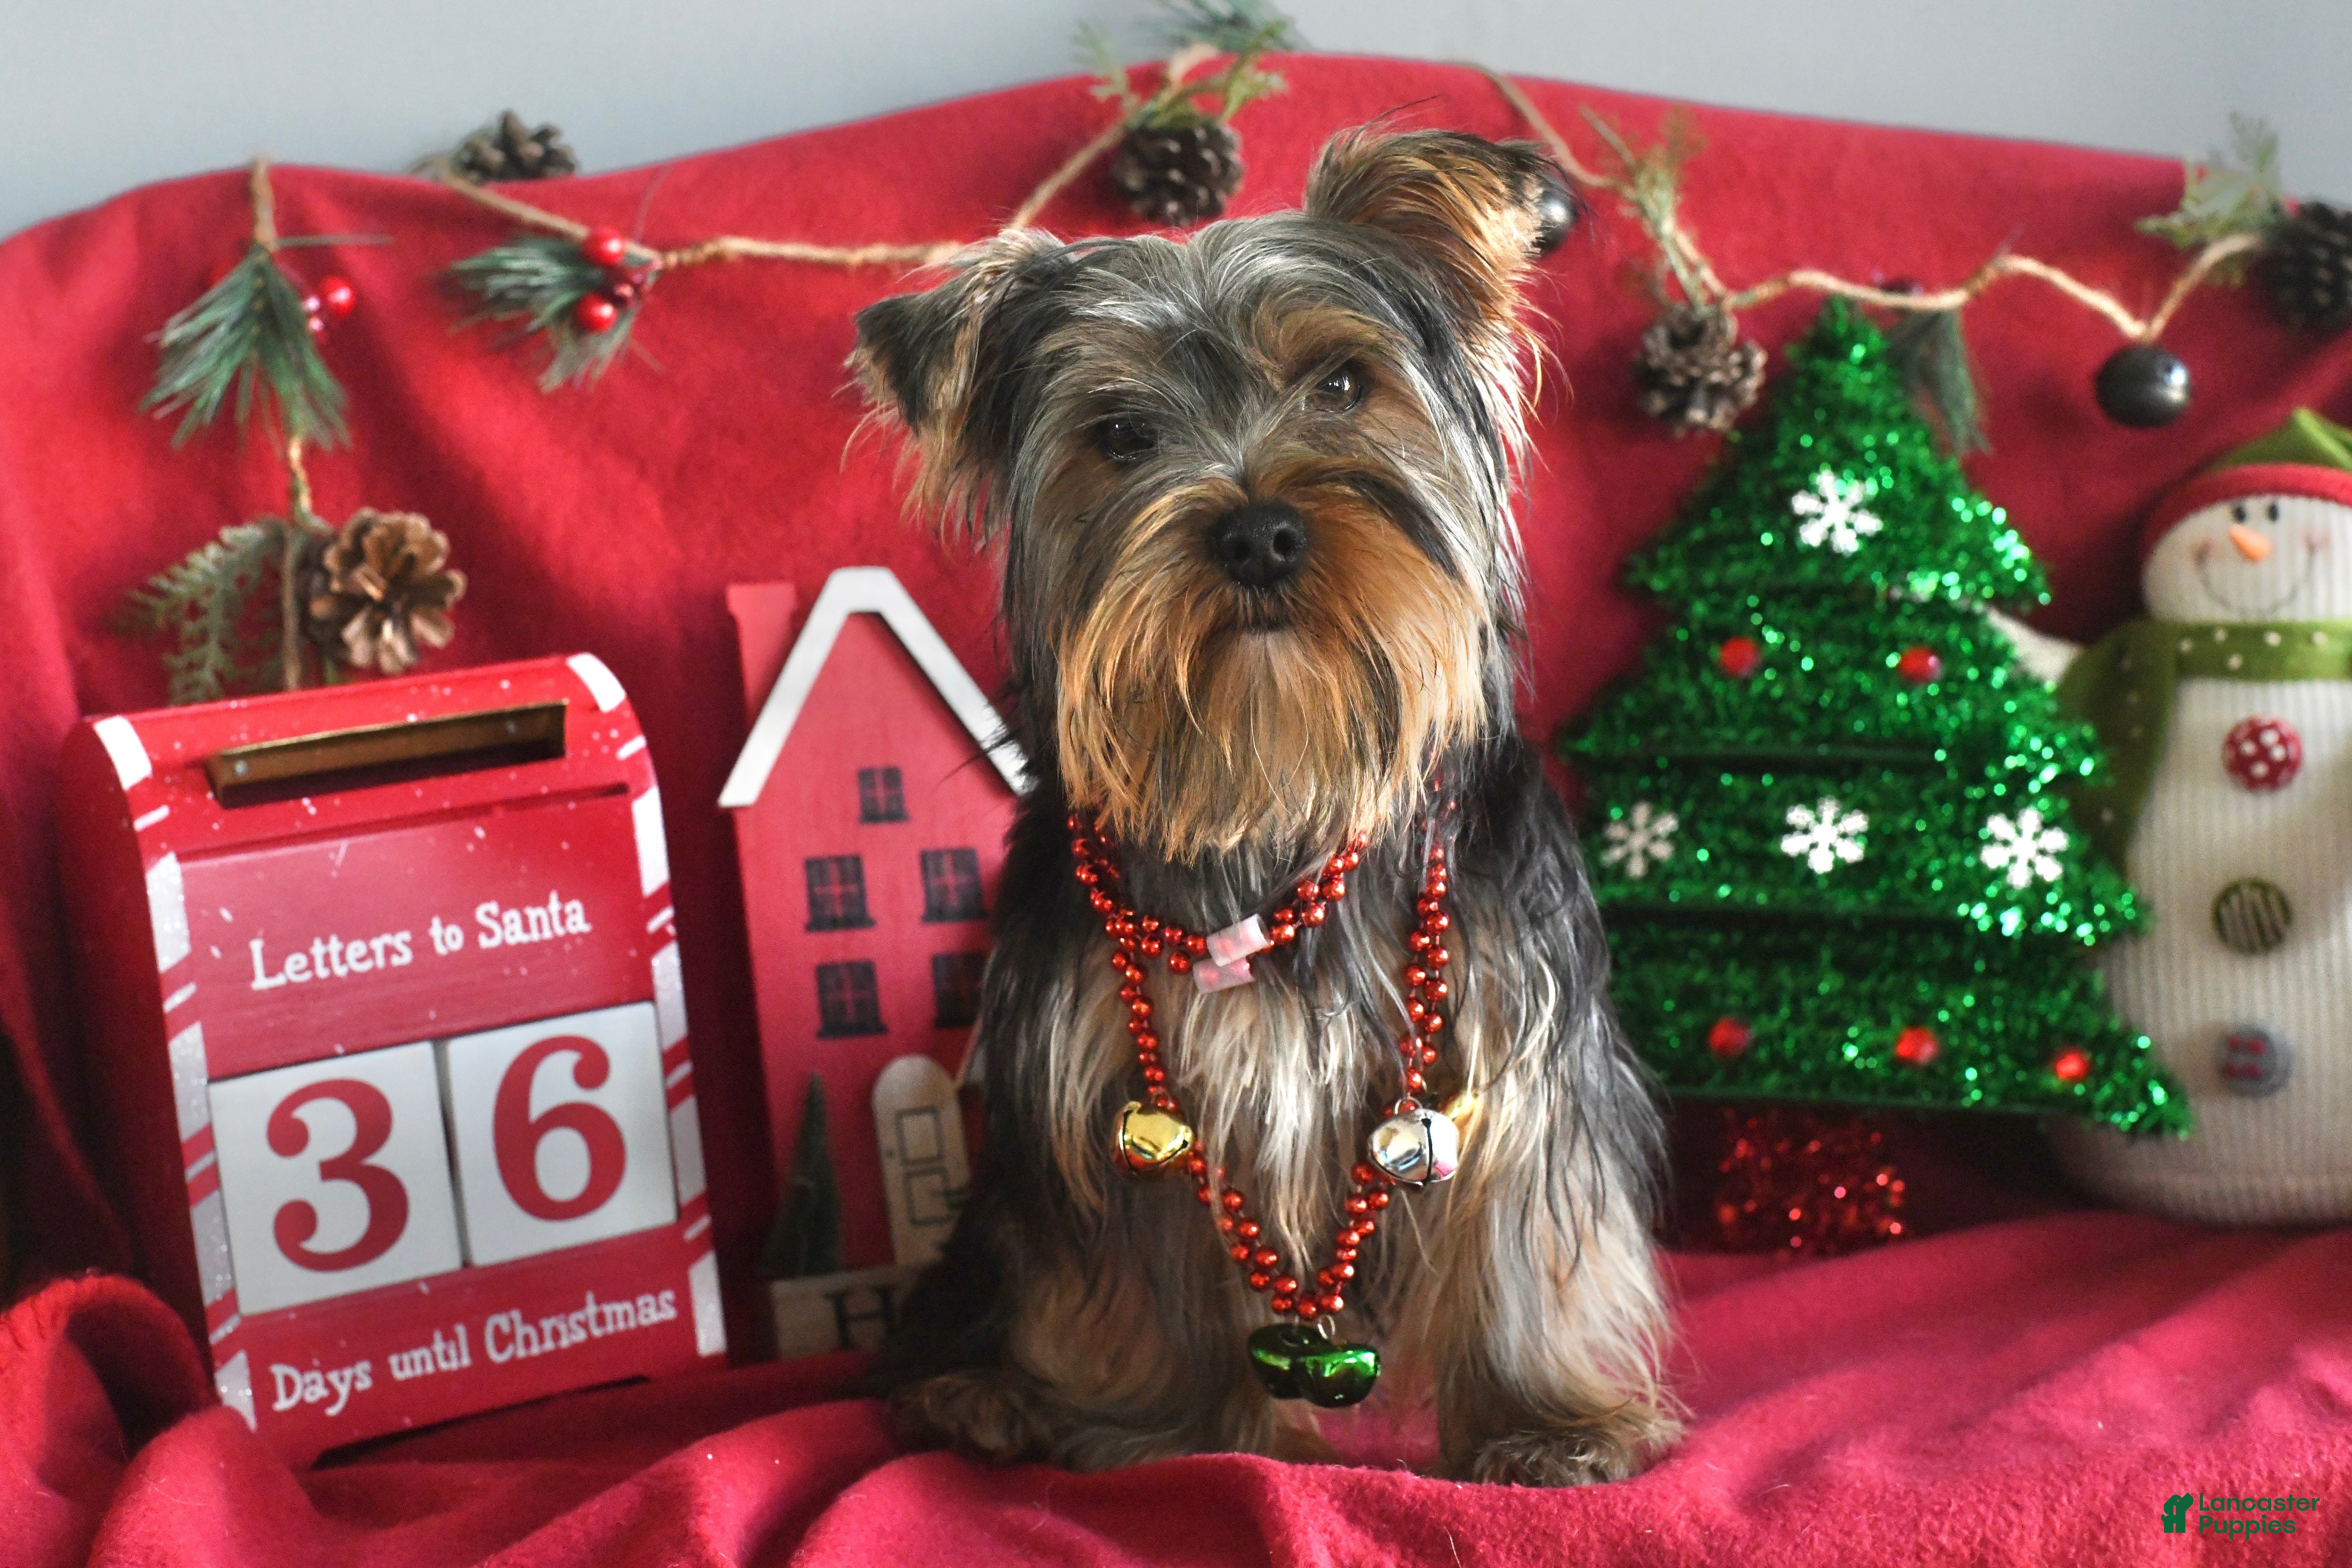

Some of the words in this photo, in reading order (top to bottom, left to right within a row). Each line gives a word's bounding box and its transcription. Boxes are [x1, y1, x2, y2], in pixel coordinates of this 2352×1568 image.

[250, 931, 413, 990] Letters
[429, 915, 464, 956] to
[475, 890, 591, 949] Santa
[270, 1362, 373, 1416] Days
[388, 1323, 473, 1381] until
[484, 1289, 677, 1363] Christmas
